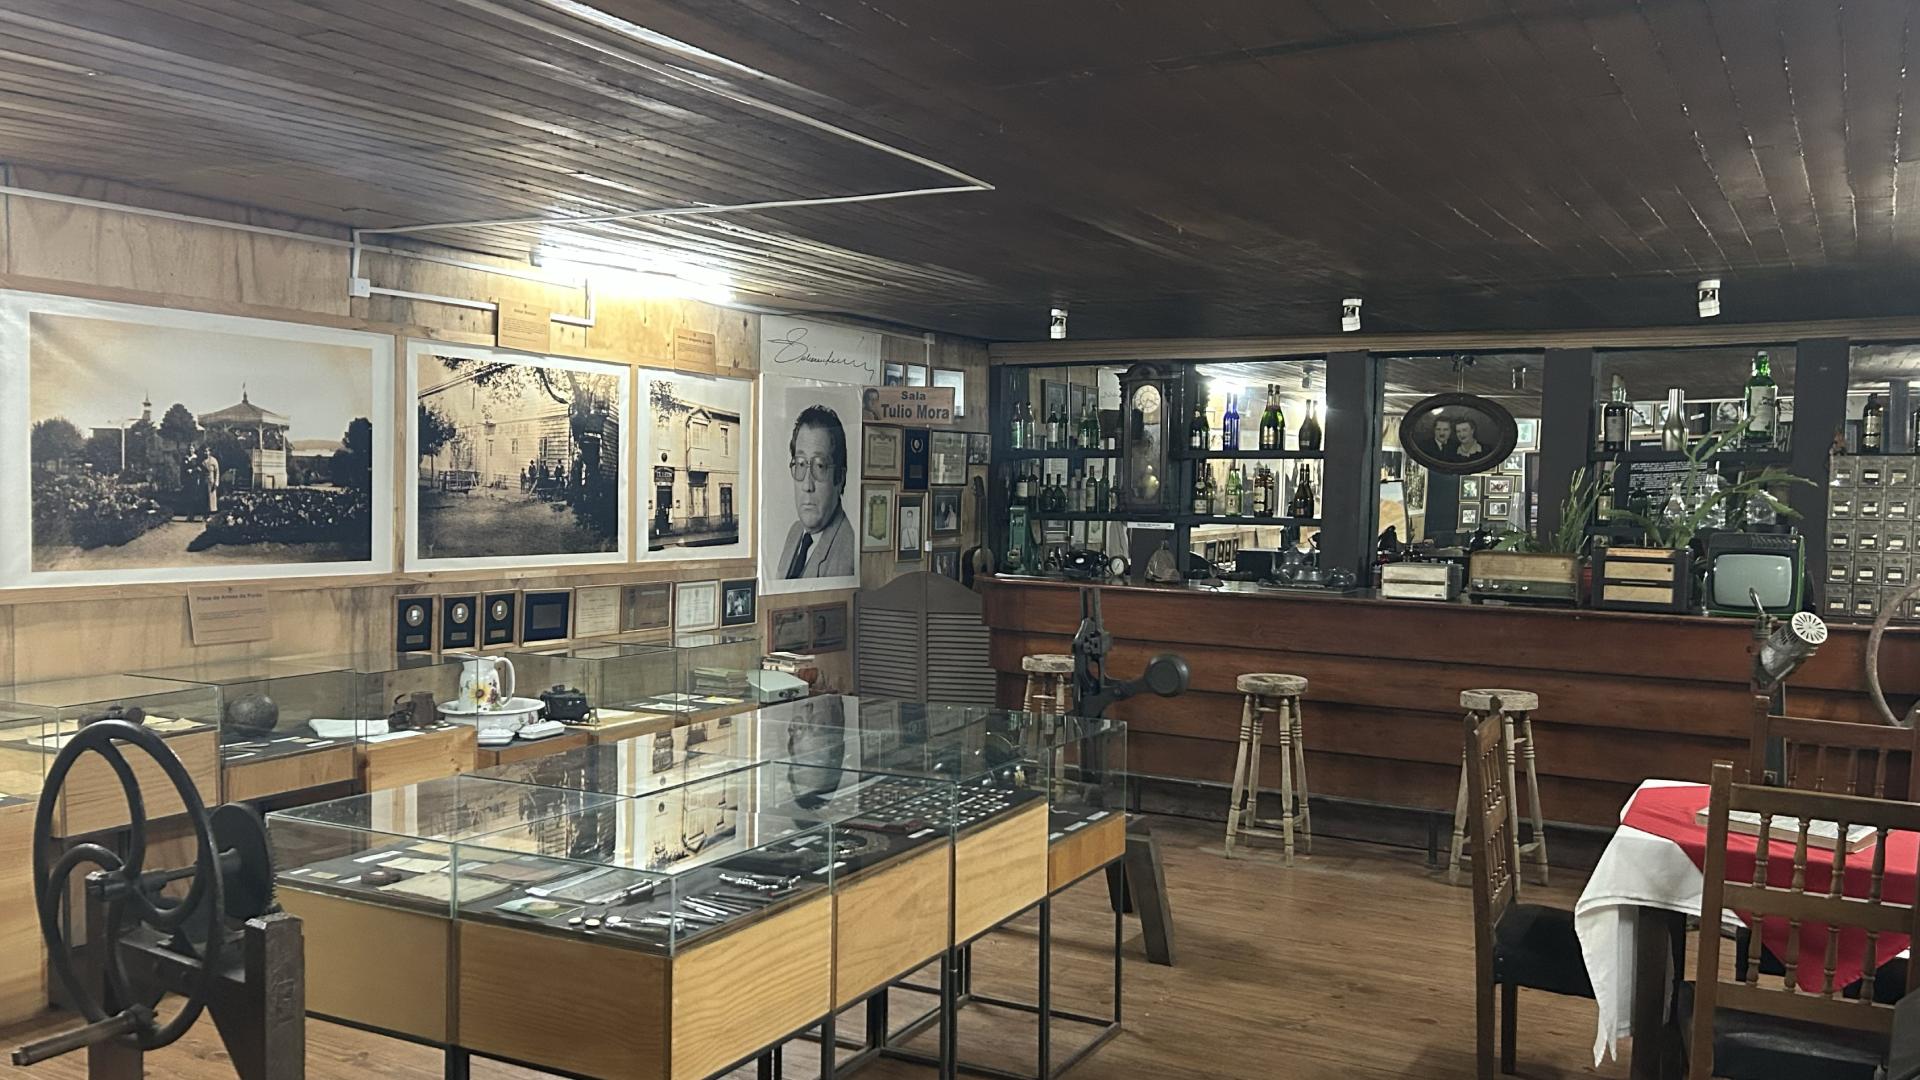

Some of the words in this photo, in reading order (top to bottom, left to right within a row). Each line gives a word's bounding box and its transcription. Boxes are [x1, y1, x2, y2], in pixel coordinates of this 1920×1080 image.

[901, 390, 926, 401] Sala
[881, 404, 913, 418] Tulio
[916, 404, 950, 419] Mora
